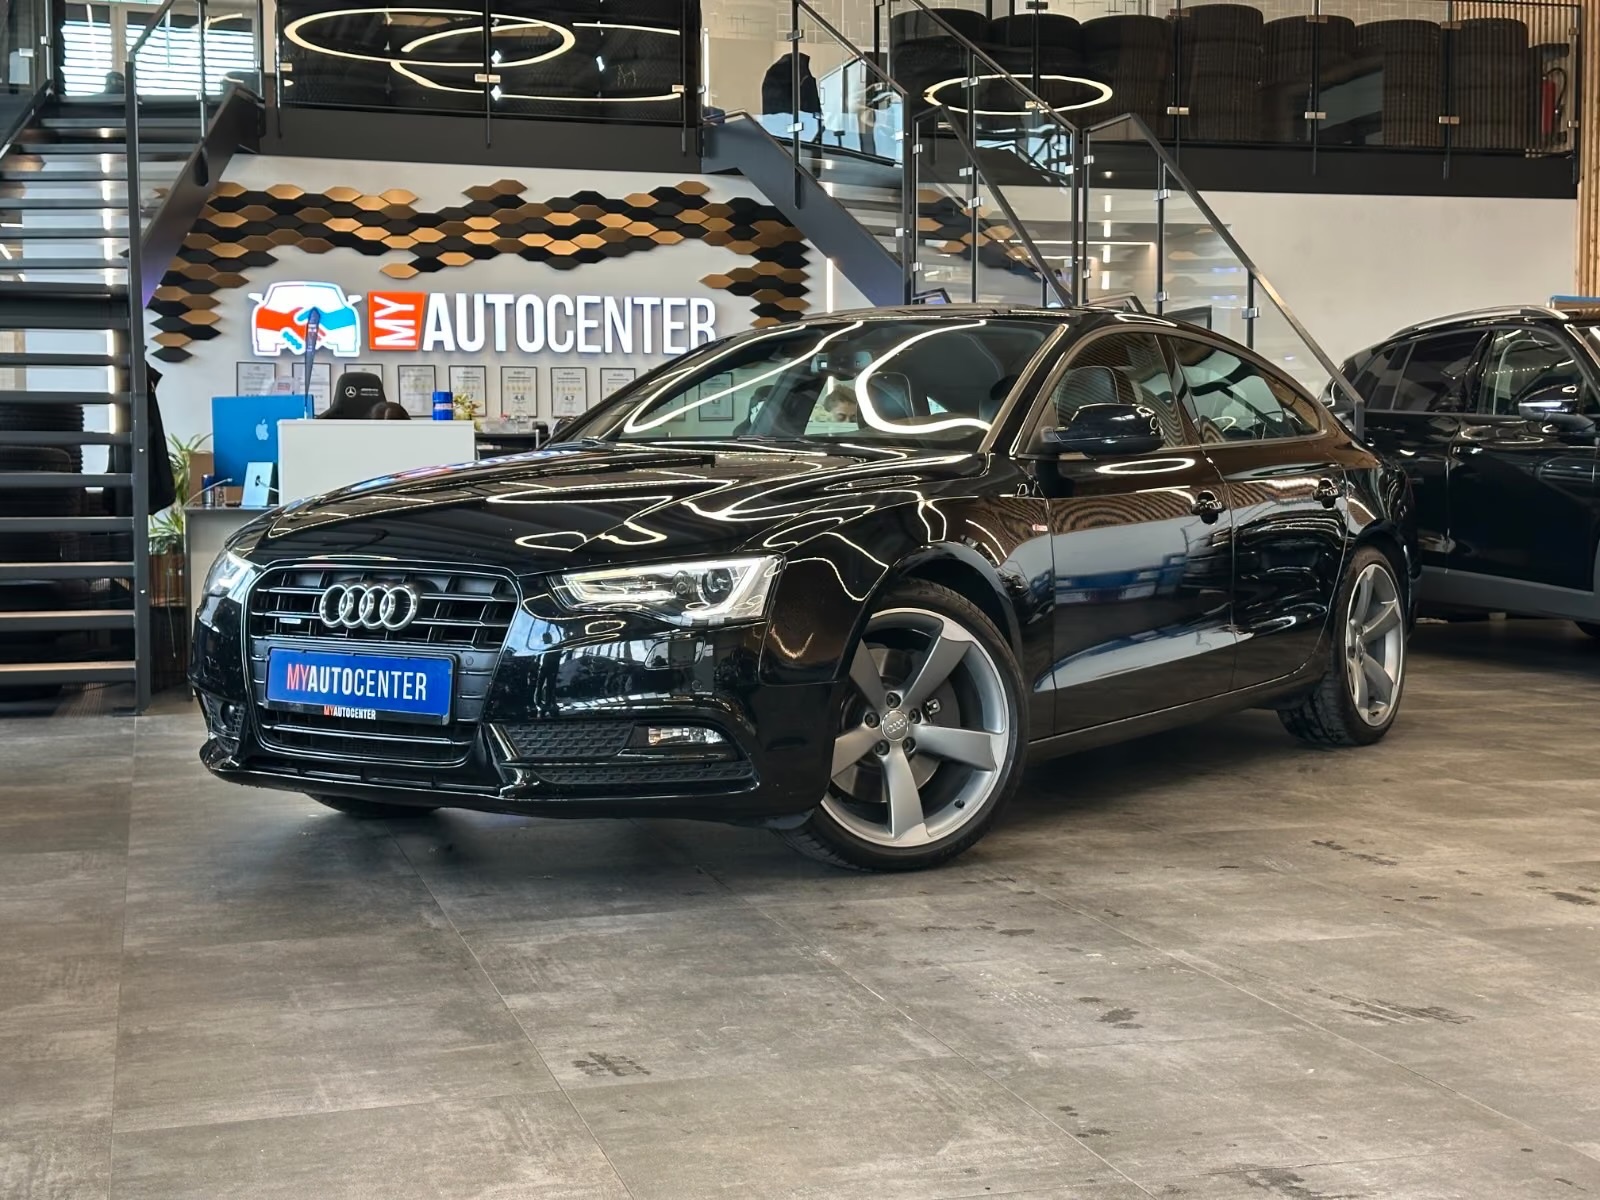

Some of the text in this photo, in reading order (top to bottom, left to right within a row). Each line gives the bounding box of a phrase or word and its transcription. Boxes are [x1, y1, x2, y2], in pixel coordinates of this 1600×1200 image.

[373, 292, 716, 354] MY AUTOCENTER
[286, 663, 427, 701] MYAUTOCENTER
[323, 704, 377, 721] MYAUTOCENTER
